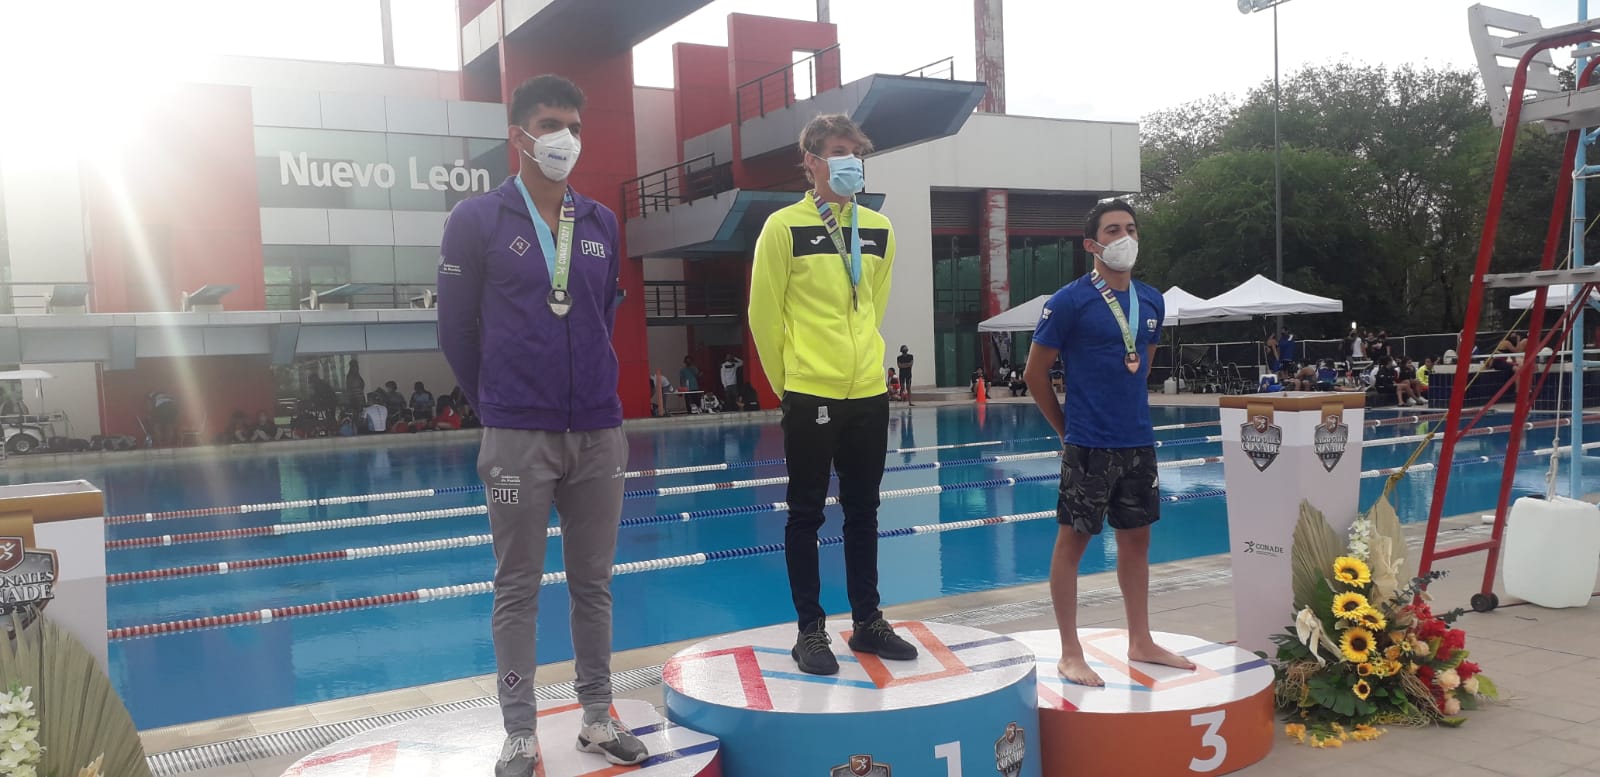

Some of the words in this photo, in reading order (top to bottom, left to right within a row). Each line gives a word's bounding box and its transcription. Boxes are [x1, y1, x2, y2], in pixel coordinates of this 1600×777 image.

[279, 150, 395, 188] Nuevo
[409, 156, 490, 192] León
[581, 239, 606, 258] PUE
[491, 487, 519, 504] PUE
[934, 740, 962, 777] 1
[1189, 709, 1228, 773] 3
